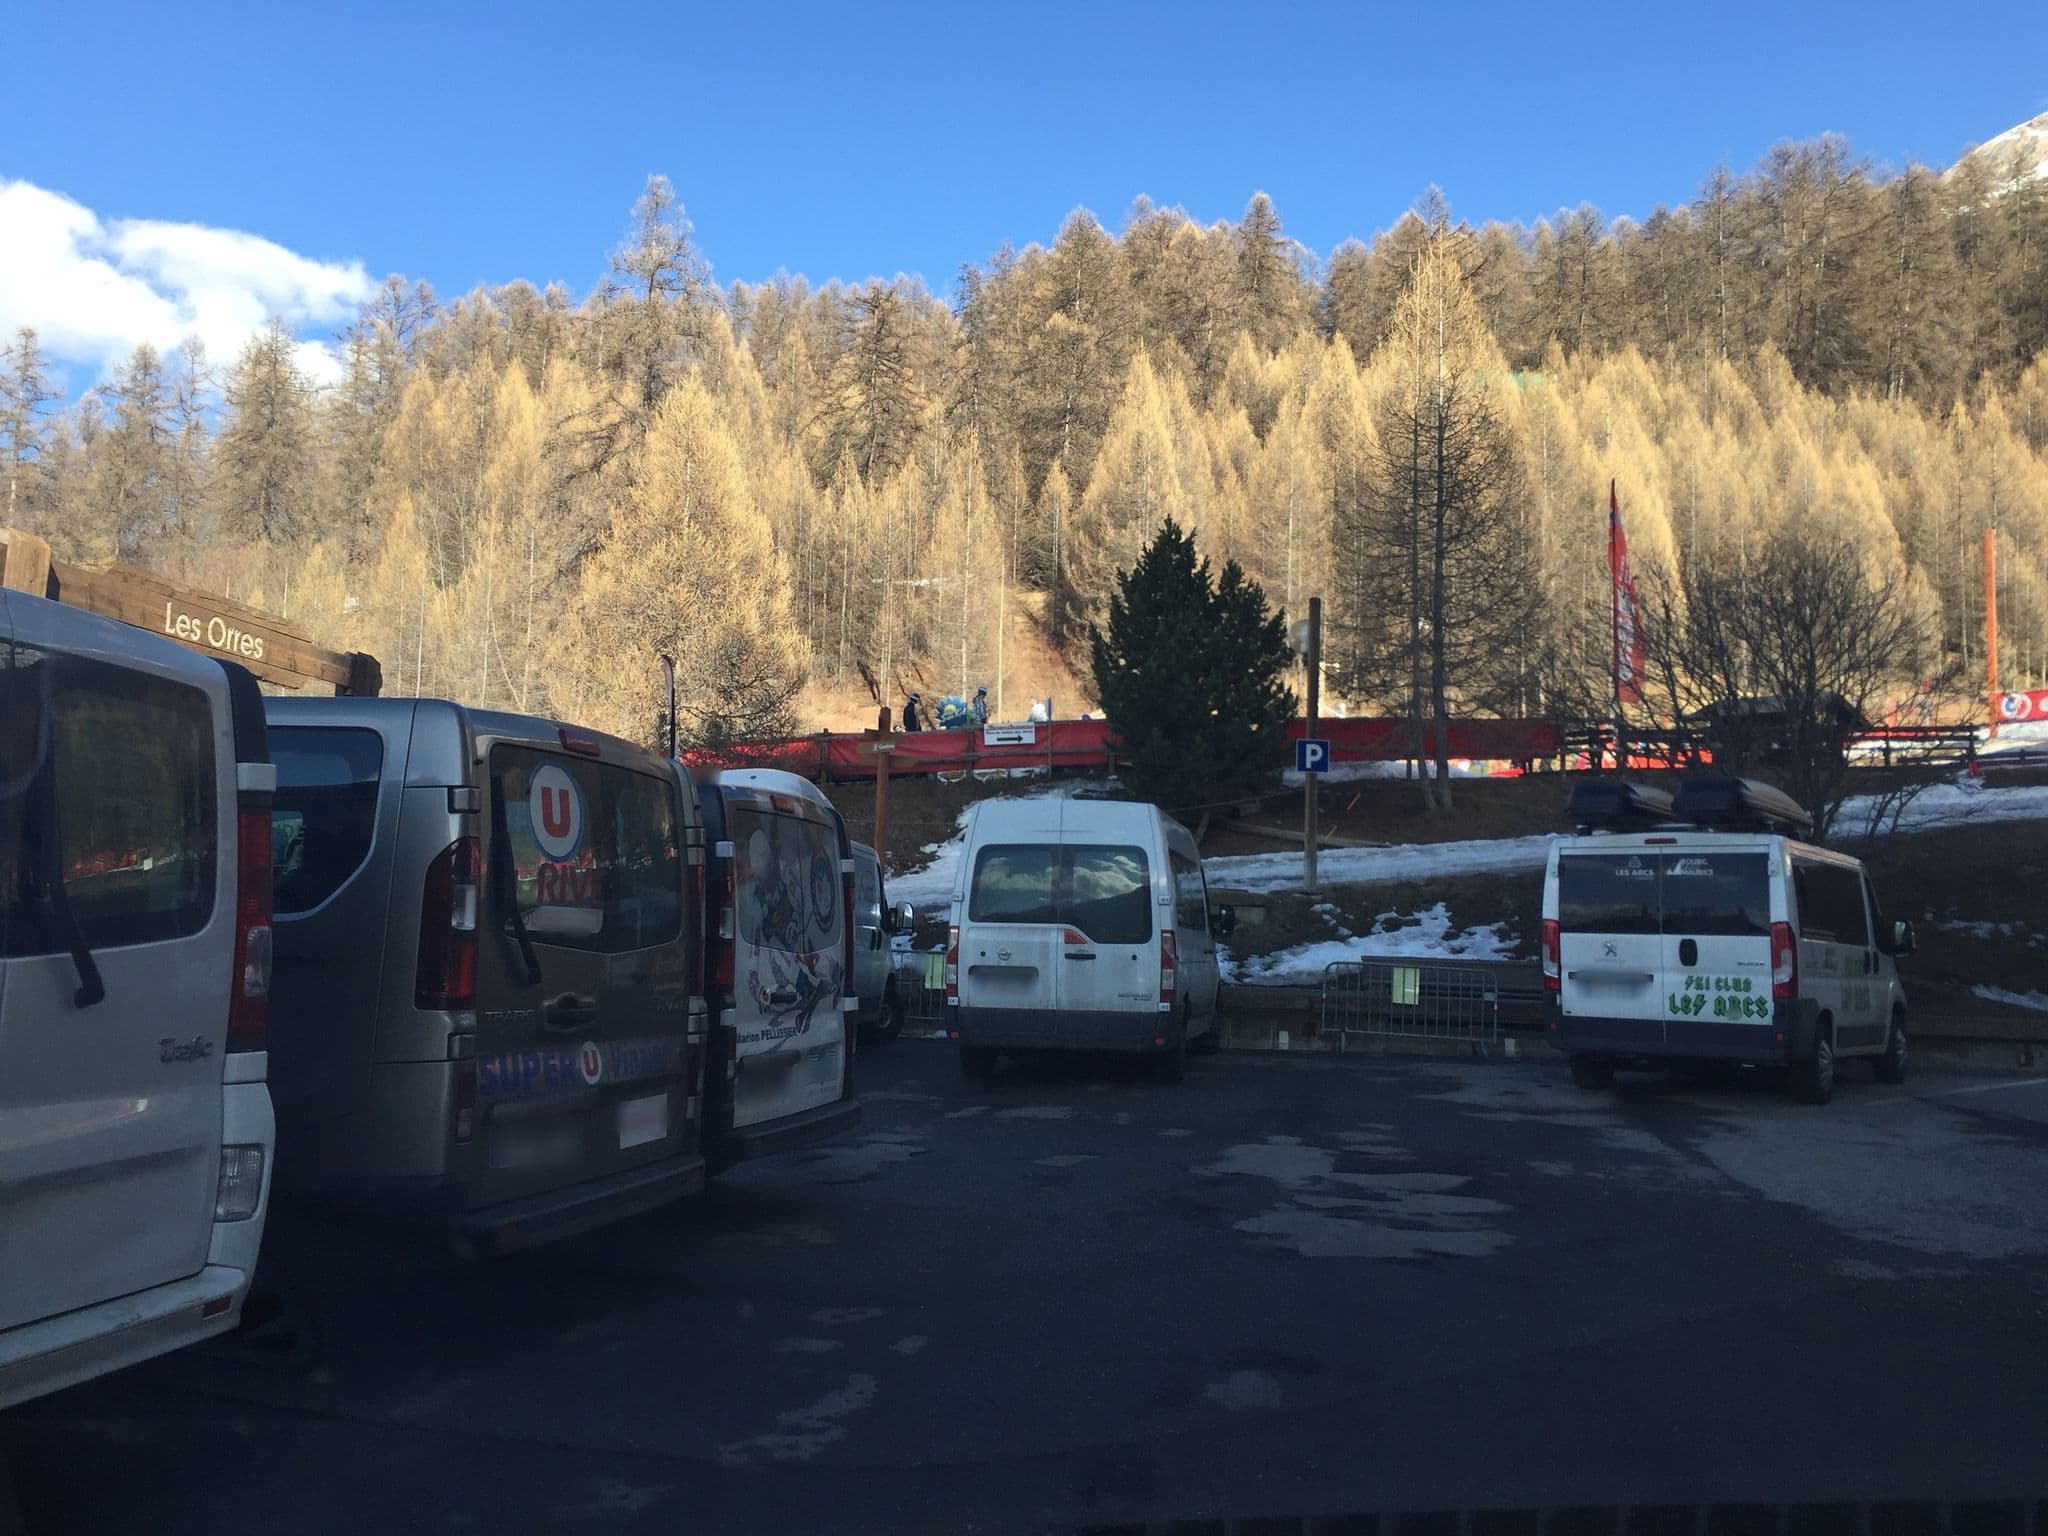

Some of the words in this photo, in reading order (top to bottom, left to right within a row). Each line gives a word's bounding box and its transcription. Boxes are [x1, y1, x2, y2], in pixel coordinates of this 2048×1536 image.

[165, 602, 201, 641] Les
[208, 616, 264, 659] Orres
[1306, 744, 1323, 769] P
[541, 786, 572, 838] U
[1615, 868, 1630, 876] LES
[1631, 868, 1655, 876] ARCS
[1669, 992, 1707, 1017] LES
[1713, 994, 1769, 1019] ARCS
[479, 1049, 578, 1095] SUPER
